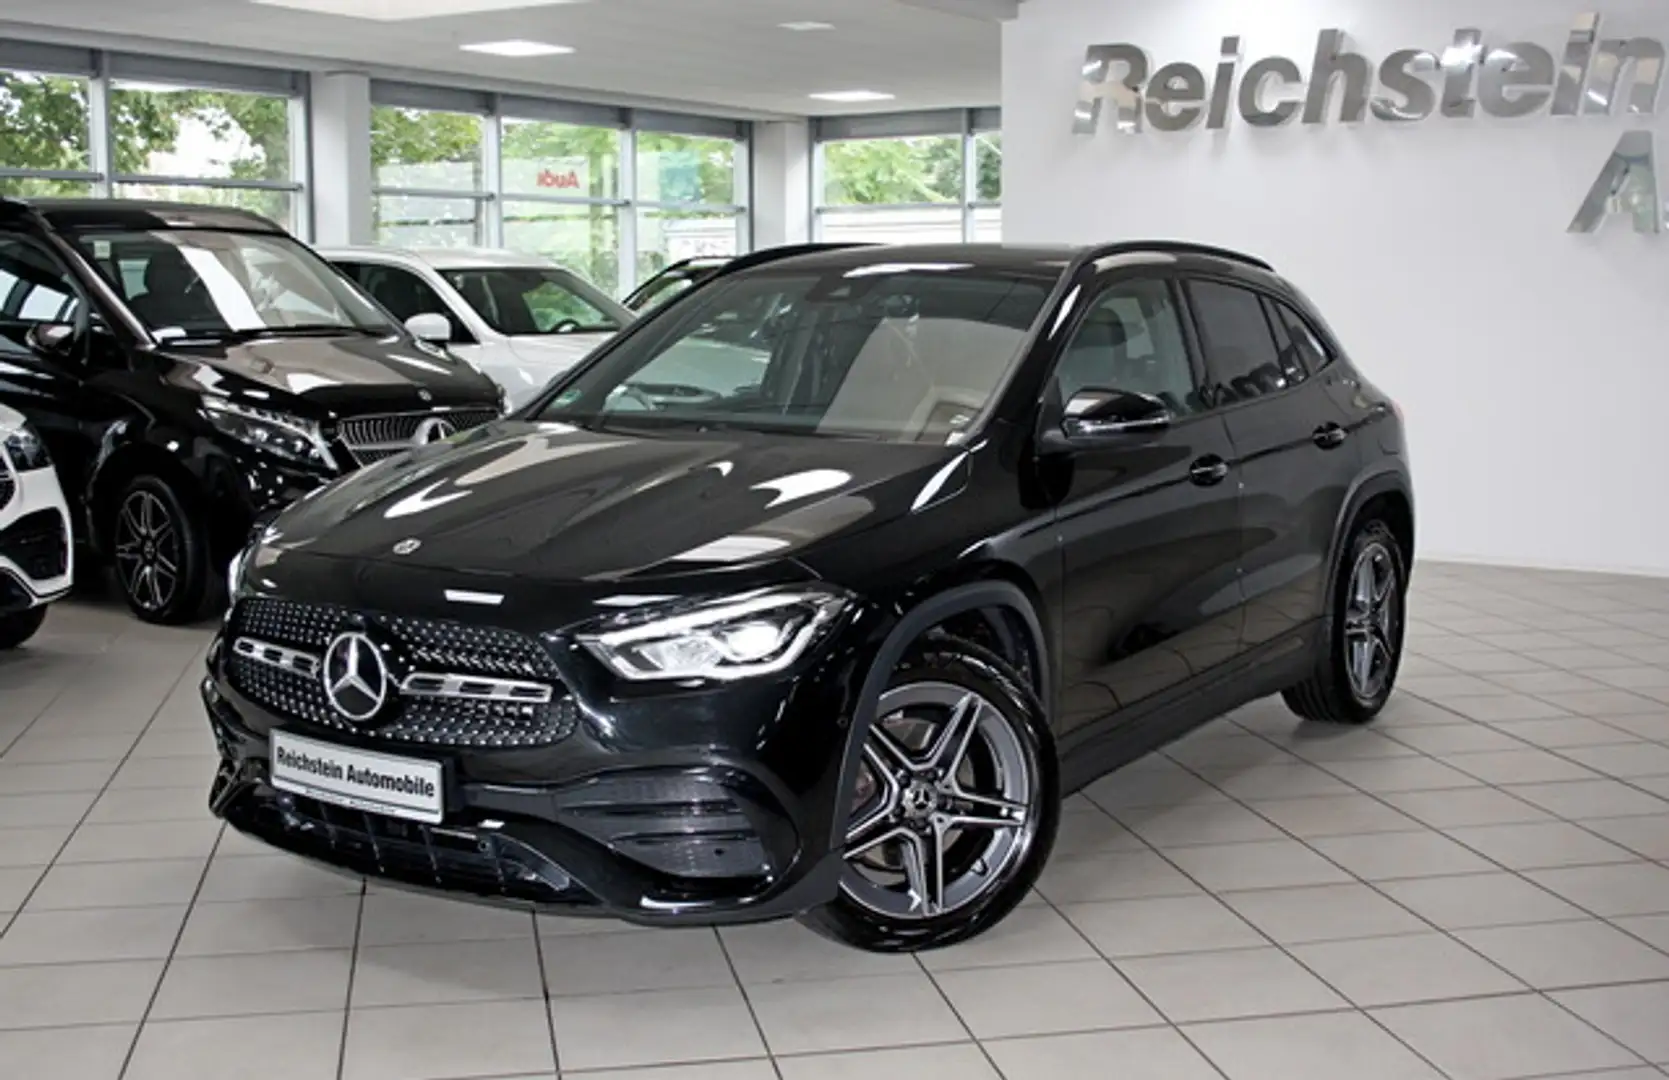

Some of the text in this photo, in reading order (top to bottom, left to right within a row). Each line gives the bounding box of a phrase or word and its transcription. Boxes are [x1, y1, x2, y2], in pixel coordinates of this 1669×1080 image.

[1072, 12, 1667, 135] Reichstein
[1565, 129, 1669, 234] A
[276, 746, 435, 797] Reichstein Automobile
